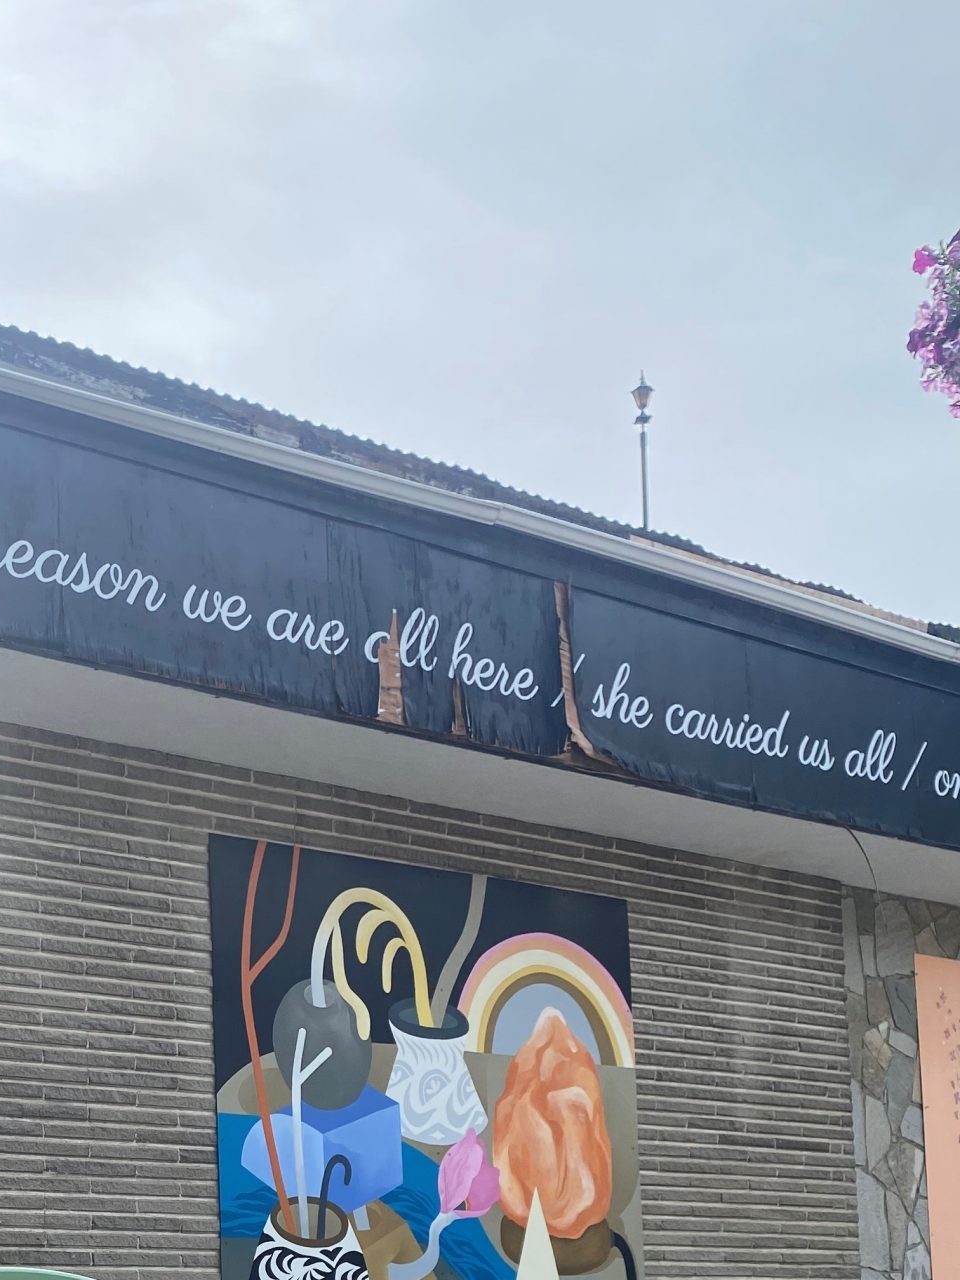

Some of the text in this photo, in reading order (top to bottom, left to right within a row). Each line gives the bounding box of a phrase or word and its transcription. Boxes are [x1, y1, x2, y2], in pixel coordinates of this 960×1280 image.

[183, 584, 252, 631] we
[267, 609, 349, 655] are
[448, 622, 539, 700] here
[591, 663, 653, 729] she
[665, 704, 790, 757] carried
[798, 735, 835, 771] us
[845, 729, 896, 783] all
